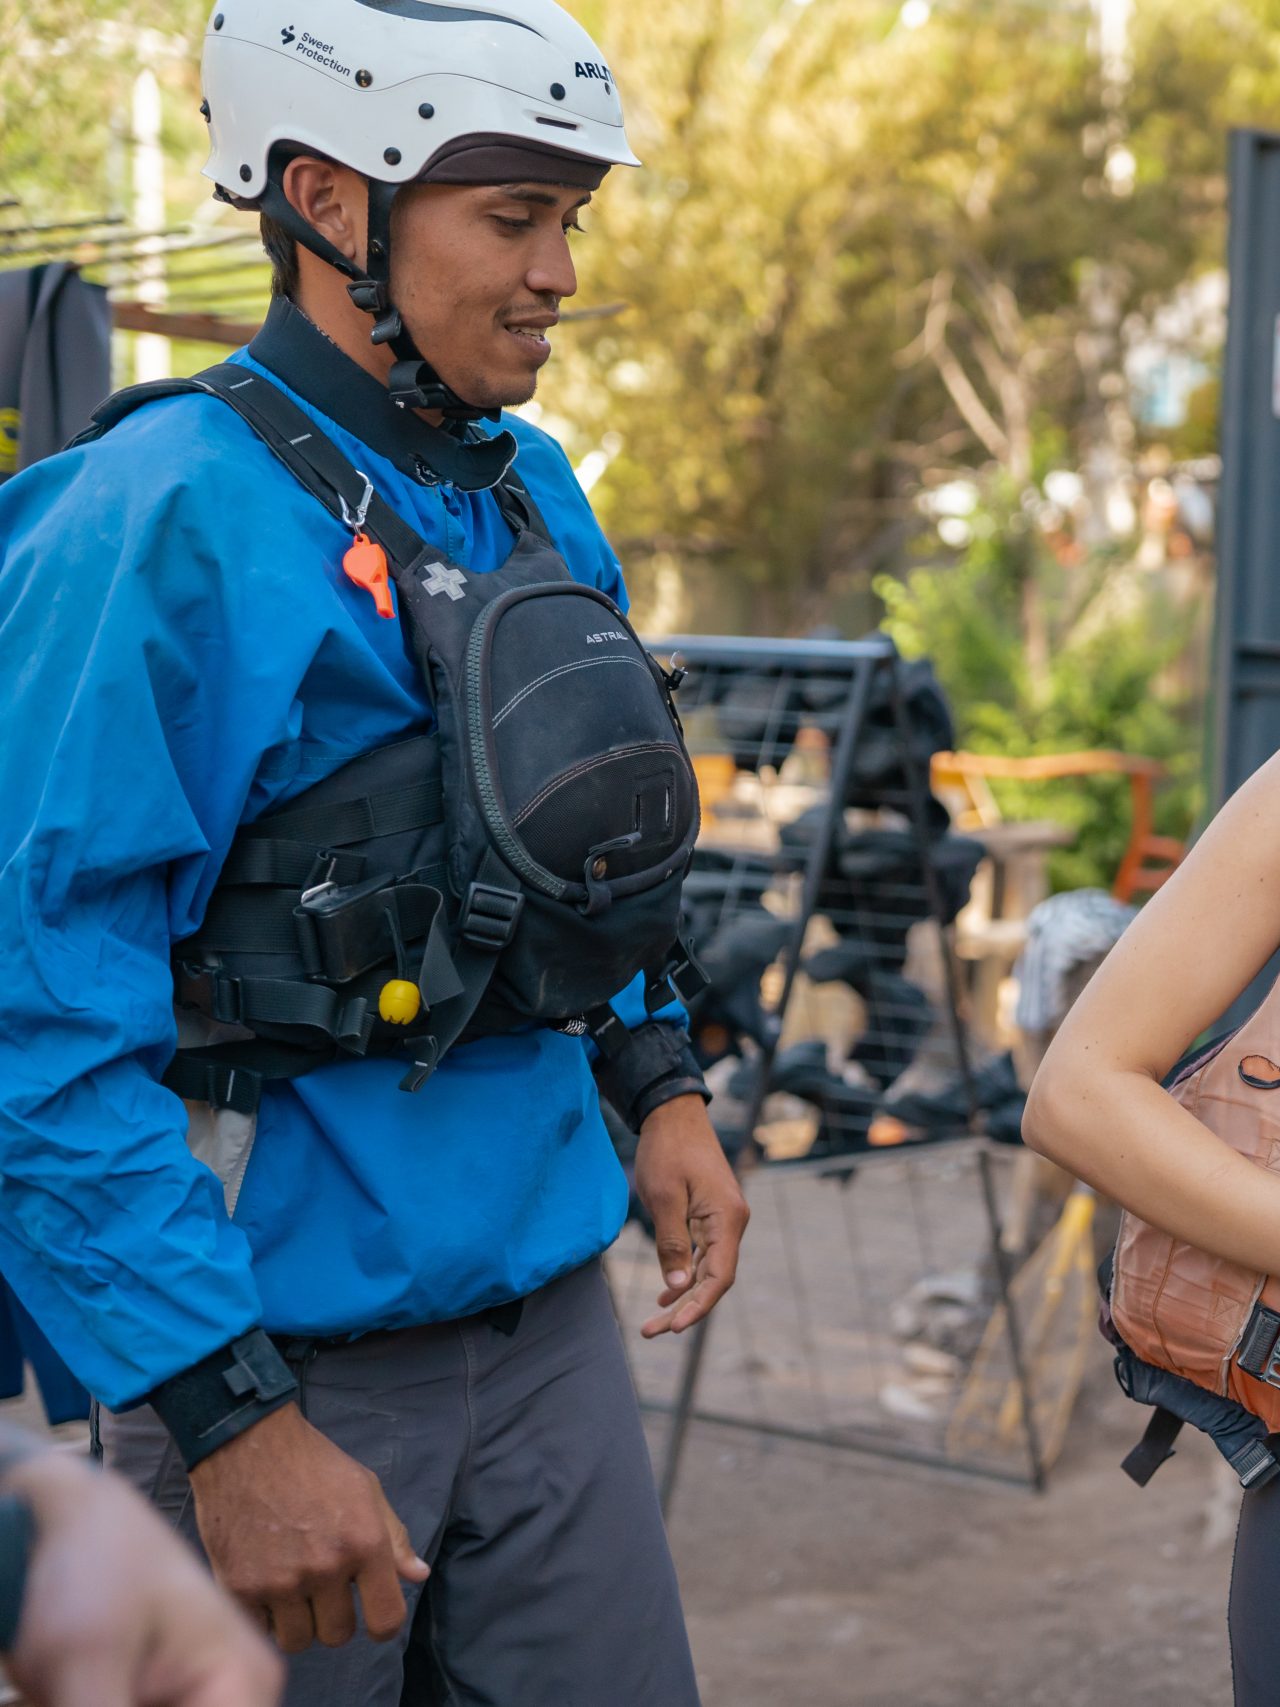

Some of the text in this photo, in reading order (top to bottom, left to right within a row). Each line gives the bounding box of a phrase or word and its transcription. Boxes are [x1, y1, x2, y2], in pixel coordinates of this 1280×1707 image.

[301, 32, 335, 55] Sweet
[295, 42, 351, 77] Protection
[586, 631, 628, 644] ASTRAL
